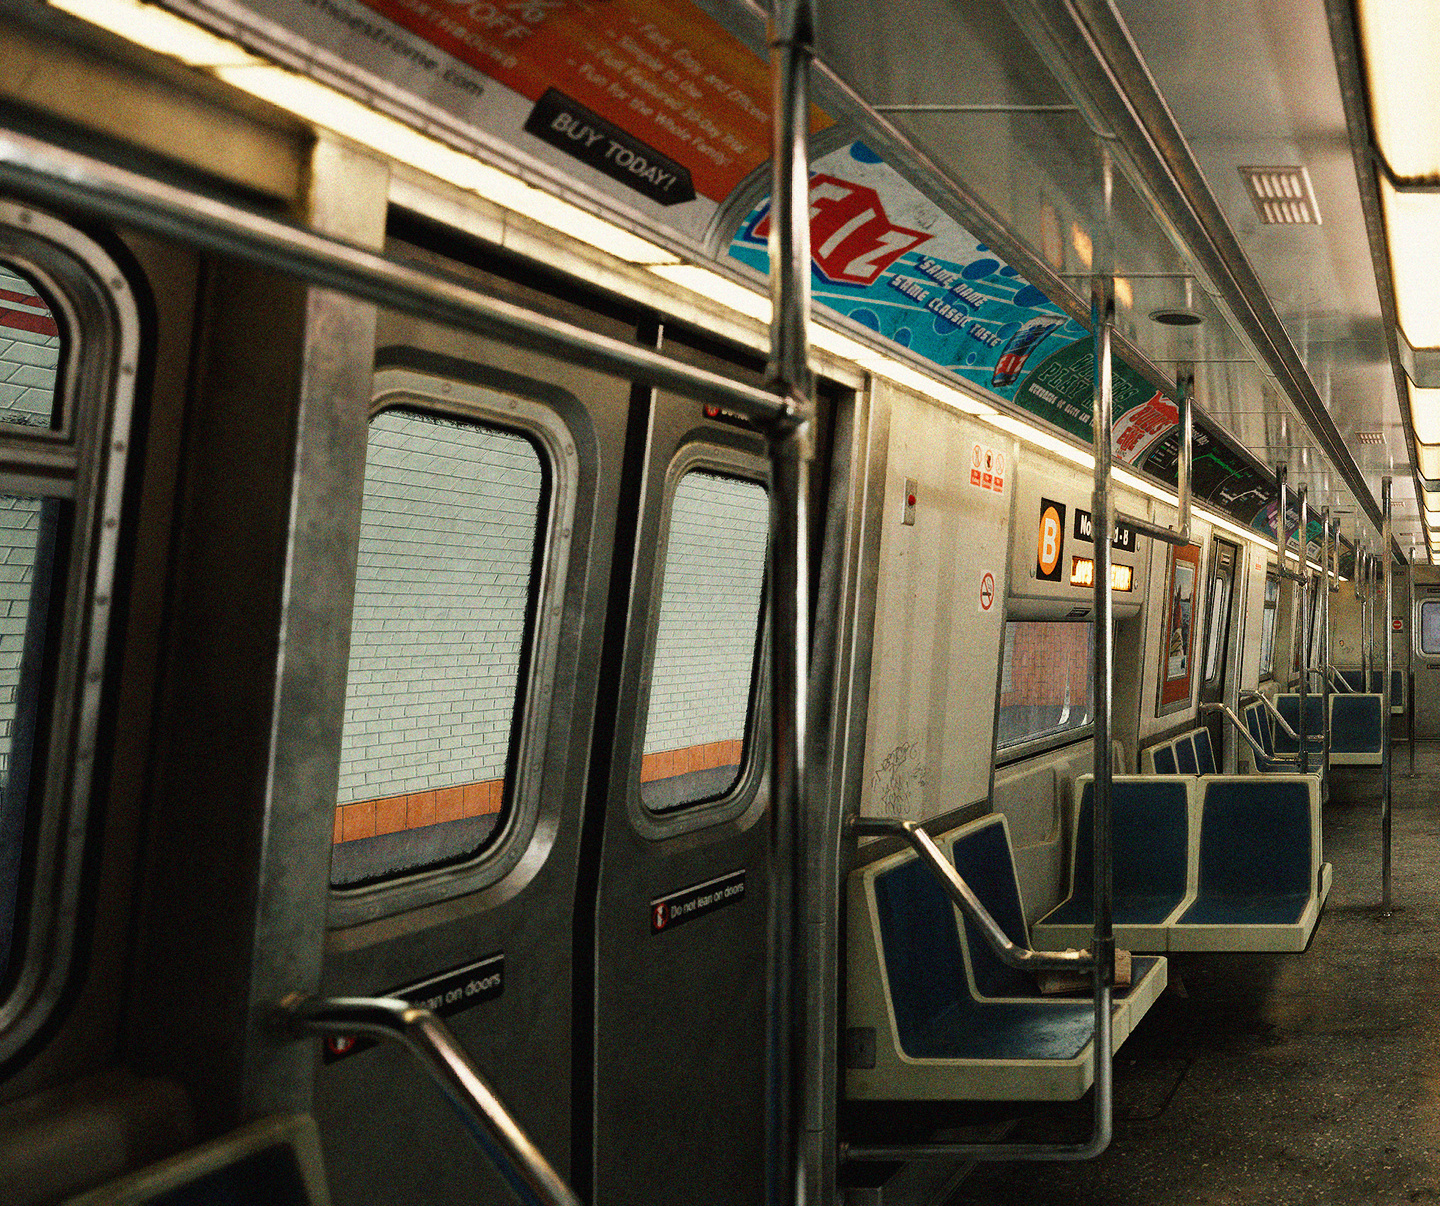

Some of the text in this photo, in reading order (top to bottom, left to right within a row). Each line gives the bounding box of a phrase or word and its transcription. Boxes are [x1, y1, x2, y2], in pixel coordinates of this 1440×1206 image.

[580, 63, 607, 87] Fun
[551, 112, 678, 192] BUY TODAY!
[891, 273, 930, 304] SAME
[928, 296, 971, 330] CLASSIC
[1038, 361, 1089, 399] PLAY
[1042, 517, 1057, 564] B
[670, 882, 745, 920] Do not lean on doors
[445, 987, 463, 1004] on
[465, 973, 501, 997] doors
